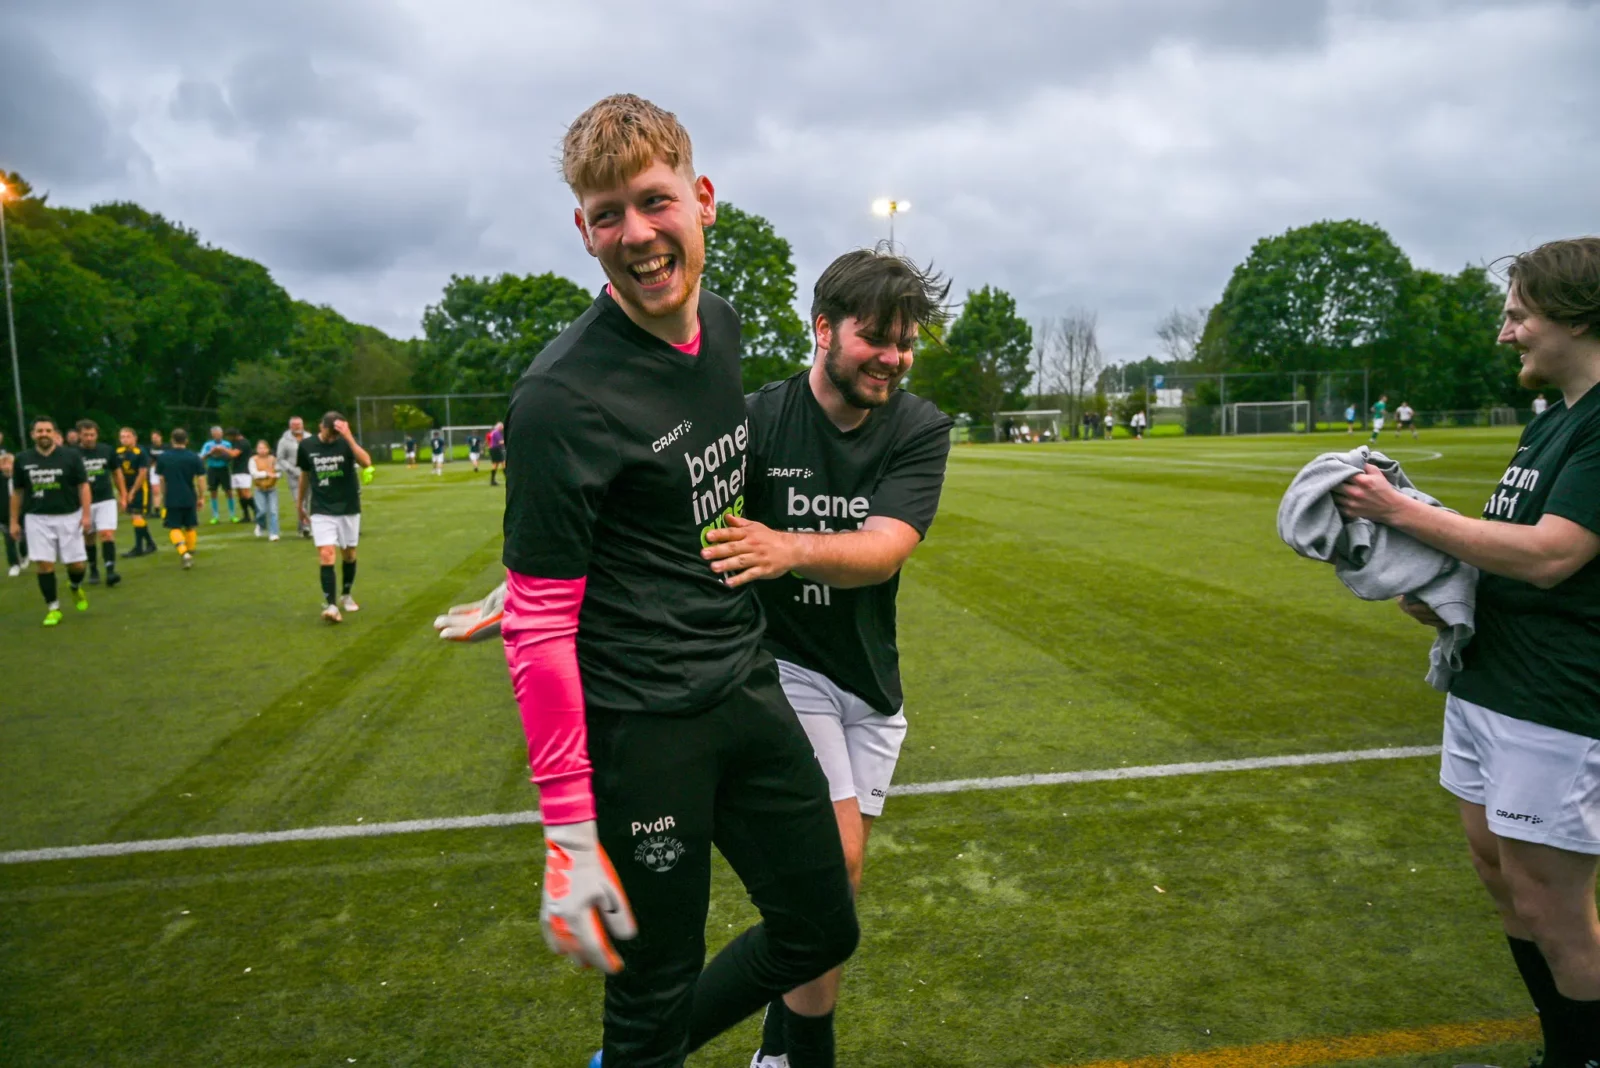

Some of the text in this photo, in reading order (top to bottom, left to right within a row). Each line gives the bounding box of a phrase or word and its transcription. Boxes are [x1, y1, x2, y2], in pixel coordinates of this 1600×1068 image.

[652, 424, 684, 453] CRAFT
[692, 454, 747, 525] inhet
[787, 487, 870, 519] bane
[794, 584, 831, 605] .nl
[631, 815, 676, 836] PvdR
[1496, 809, 1532, 822] CRAFT
[634, 835, 687, 862] STREEFKERK
